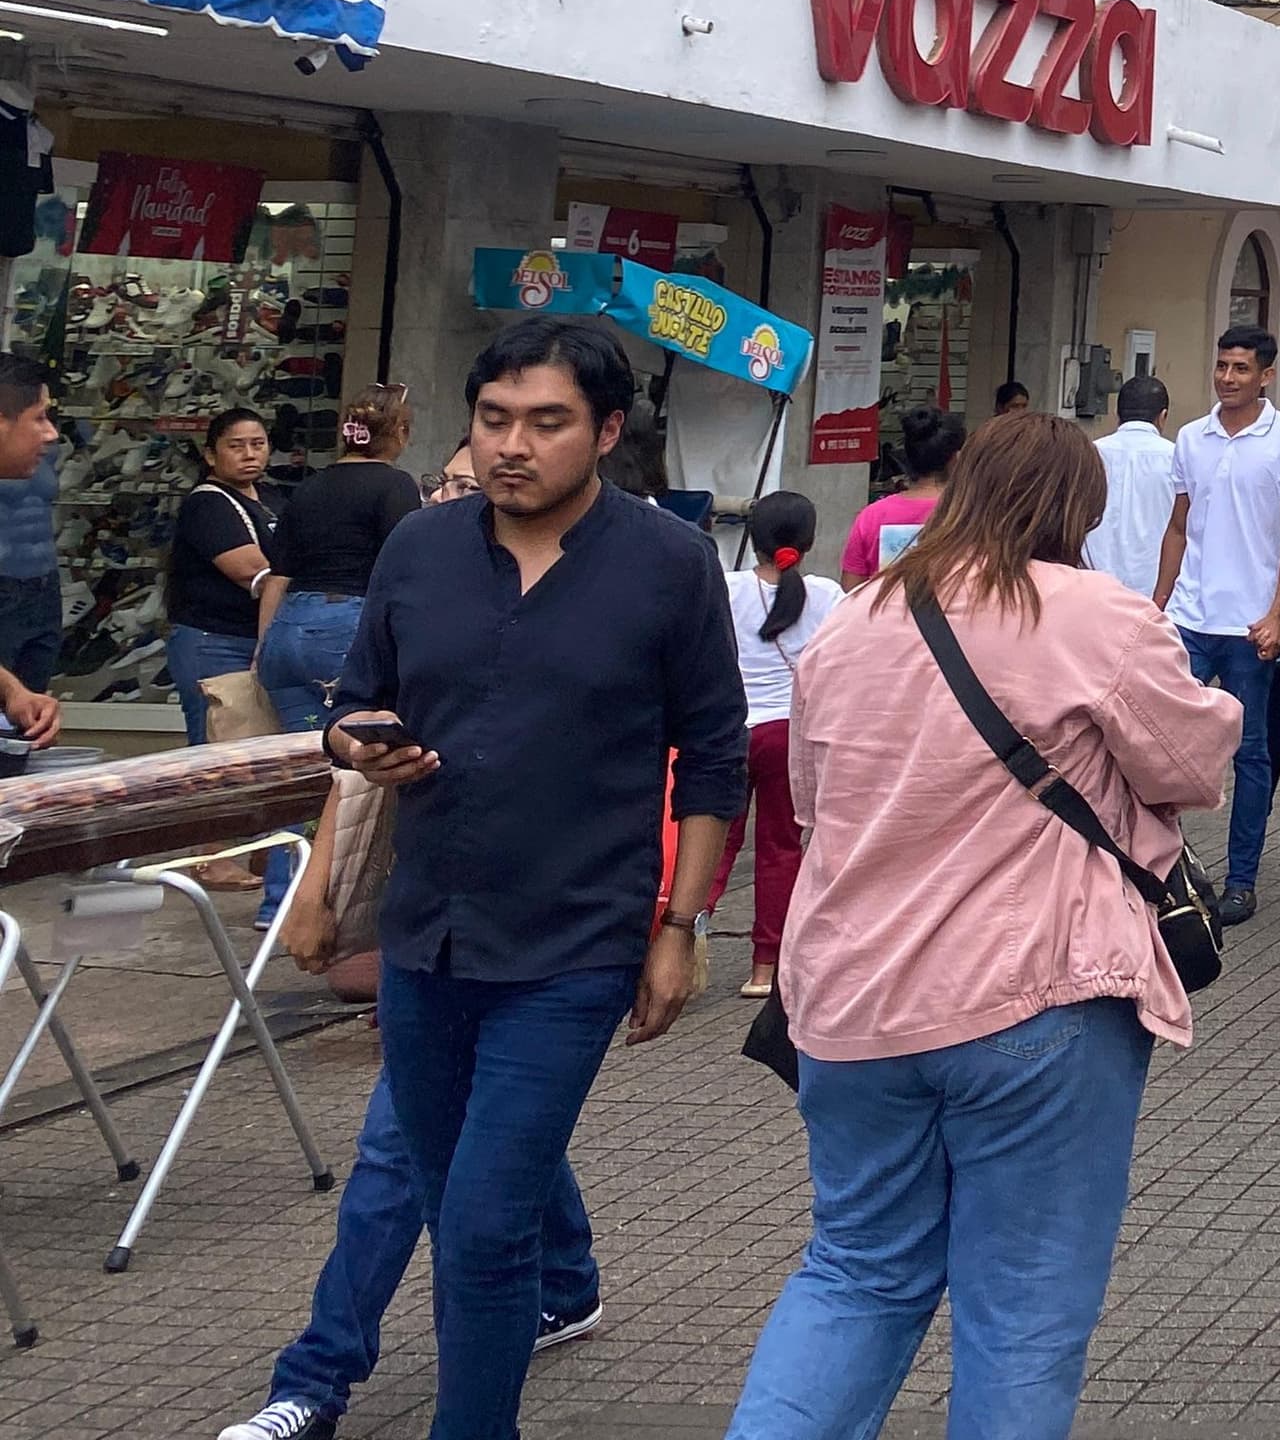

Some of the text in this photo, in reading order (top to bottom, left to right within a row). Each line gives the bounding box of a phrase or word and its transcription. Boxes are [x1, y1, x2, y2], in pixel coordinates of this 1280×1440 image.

[130, 184, 216, 227] Navidad
[628, 229, 640, 255] 6
[656, 280, 726, 332] CASTILLO
